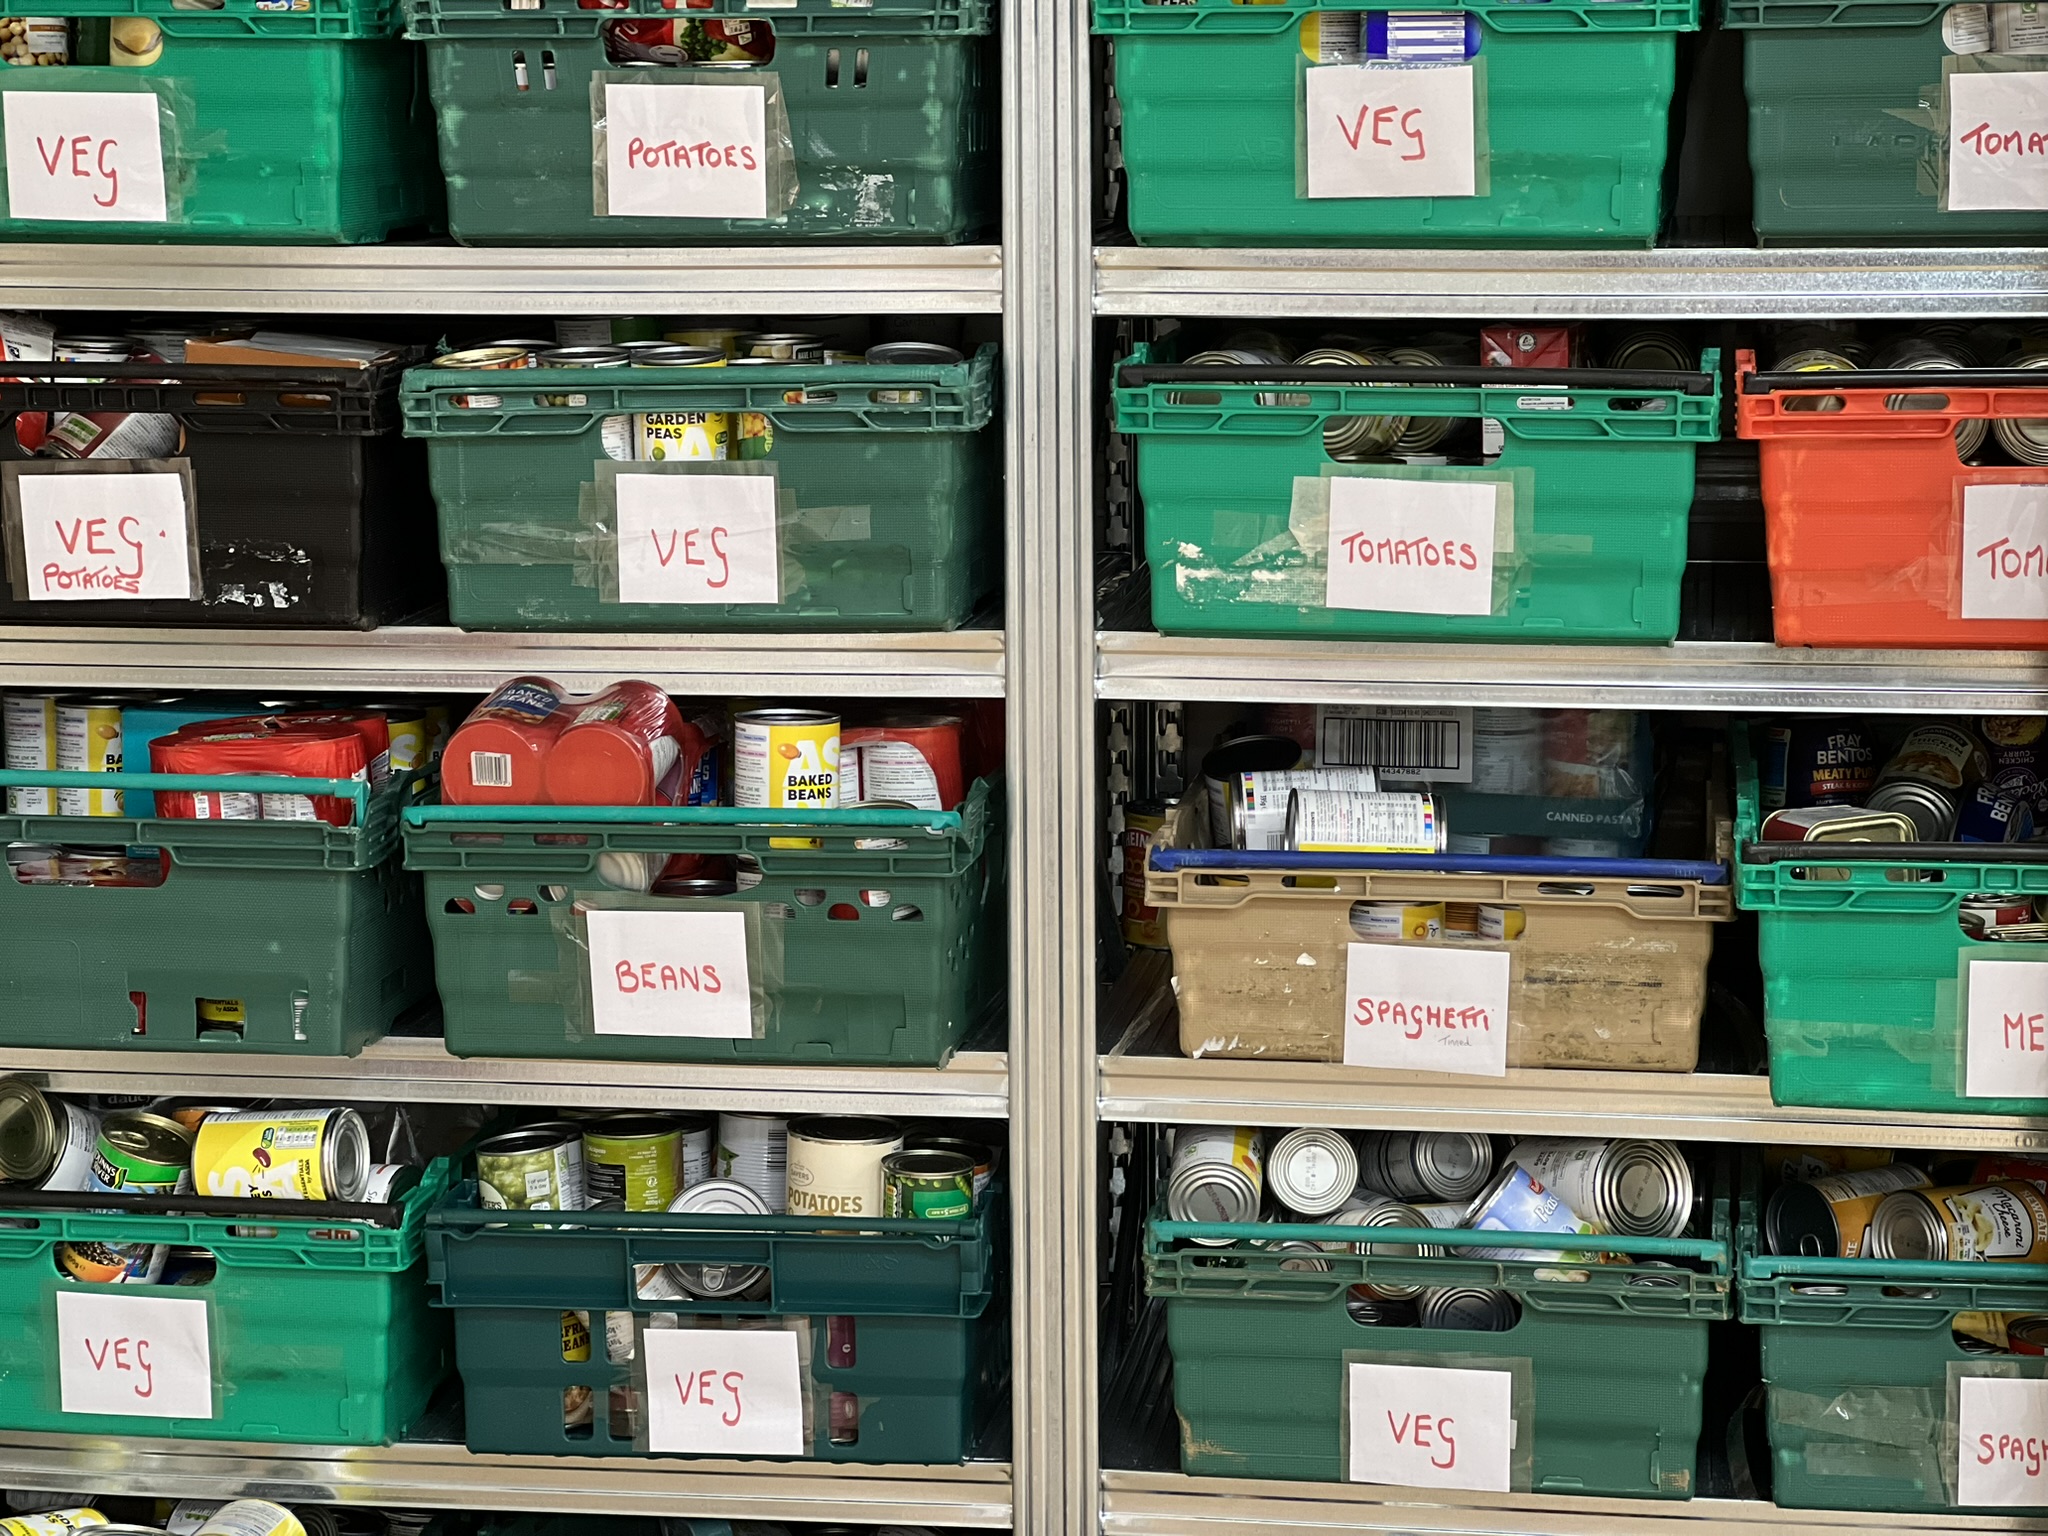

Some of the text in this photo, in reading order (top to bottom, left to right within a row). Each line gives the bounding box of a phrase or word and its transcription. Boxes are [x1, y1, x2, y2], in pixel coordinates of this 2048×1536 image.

[1337, 105, 1426, 161] VEG
[628, 137, 757, 171] POTATOES
[36, 135, 119, 207] VEG
[646, 412, 706, 426] GARDEN
[646, 427, 683, 440] PEAS
[652, 526, 729, 588] VEG
[1341, 531, 1477, 571] TOMATOES
[1977, 537, 2048, 580] TOM
[43, 562, 140, 594] POTATOES
[500, 694, 545, 708] BEANS
[507, 687, 553, 703] BAKED
[1816, 747, 1873, 765] BENTOS
[1827, 733, 1861, 750] FRAY
[1812, 767, 1852, 782] MEATY
[1998, 757, 2035, 765] CHICKEN
[788, 773, 833, 787] BAKED
[788, 787, 832, 801] BEANS
[1822, 781, 1844, 791] STEAK
[1546, 811, 1594, 824] CANNED
[1990, 791, 2017, 823] BEN
[1125, 831, 1148, 848] HEIN
[615, 959, 721, 994] BEANS
[1354, 998, 1493, 1039] SPAGHETTI
[2003, 1013, 2045, 1051] ME
[788, 1186, 863, 1214] POTATOES
[1534, 1195, 1559, 1223] Peas
[1991, 1188, 2024, 1248] Macaroni
[1991, 1202, 2011, 1238] Cheese
[85, 1337, 152, 1398] VEG
[675, 1369, 744, 1427] VEG
[1387, 1409, 1456, 1470] VEG
